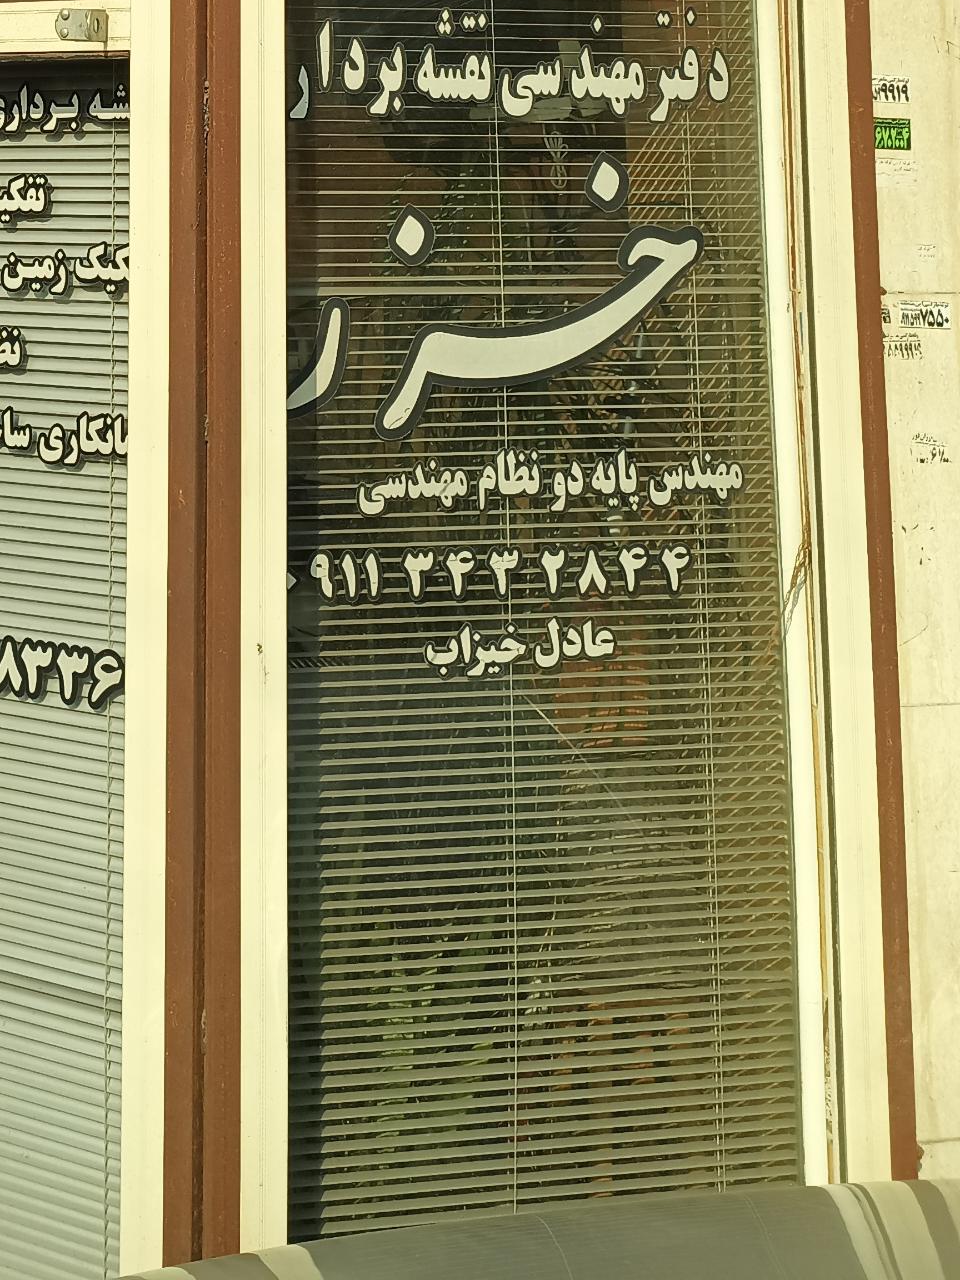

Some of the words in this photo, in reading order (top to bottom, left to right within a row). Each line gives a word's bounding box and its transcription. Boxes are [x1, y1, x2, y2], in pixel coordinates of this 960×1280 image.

[414, 7, 493, 103] نقشه
[501, 14, 647, 118] مهندسی
[647, 7, 730, 123] دفتر
[0, 248, 68, 295] زمین
[287, 151, 705, 441] خزر
[356, 456, 469, 517] مهندسی
[477, 447, 544, 512] نظام
[549, 458, 583, 513] دو
[591, 446, 639, 513] پایه
[648, 449, 745, 507] مهندس
[423, 621, 528, 679] خیزاب
[534, 616, 619, 671] عادل
